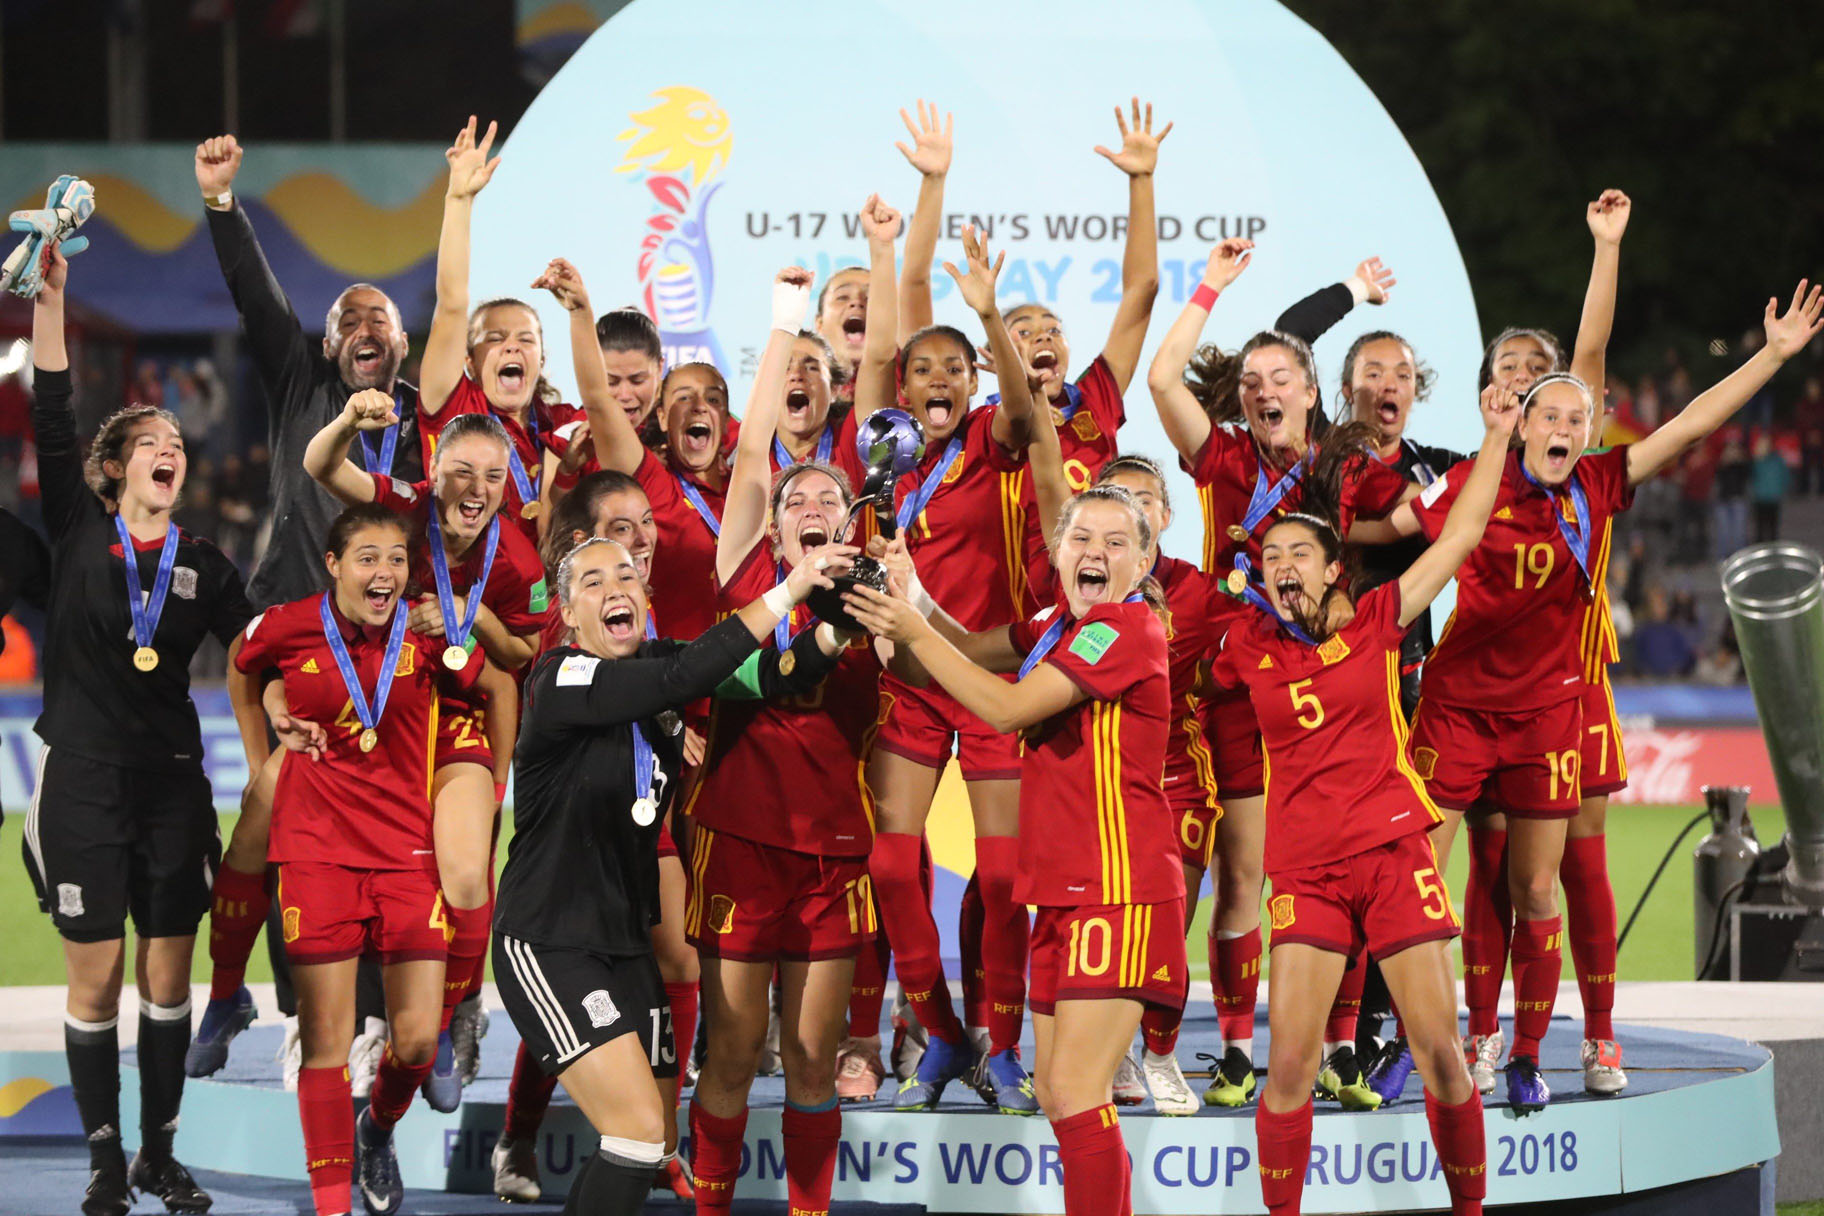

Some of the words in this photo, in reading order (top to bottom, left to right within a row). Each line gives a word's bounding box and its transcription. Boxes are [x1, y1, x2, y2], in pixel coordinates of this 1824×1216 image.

[746, 212, 827, 239] U-17
[843, 213, 1030, 241] WEN'S
[1045, 215, 1183, 242] WORD
[1195, 216, 1267, 243] CUP
[1091, 257, 1208, 304] 218
[1513, 541, 1555, 590] 19
[1288, 677, 1325, 729] 5
[1544, 749, 1579, 801] 19
[1588, 723, 1609, 777] 7
[1413, 866, 1446, 920] 5
[1067, 916, 1112, 977] 10
[649, 1005, 677, 1067] 13
[938, 1142, 1133, 1187] WOR
[1153, 1145, 1251, 1188] CUP
[1304, 1142, 1443, 1187] RUGU
[1497, 1130, 1578, 1178] 2018
